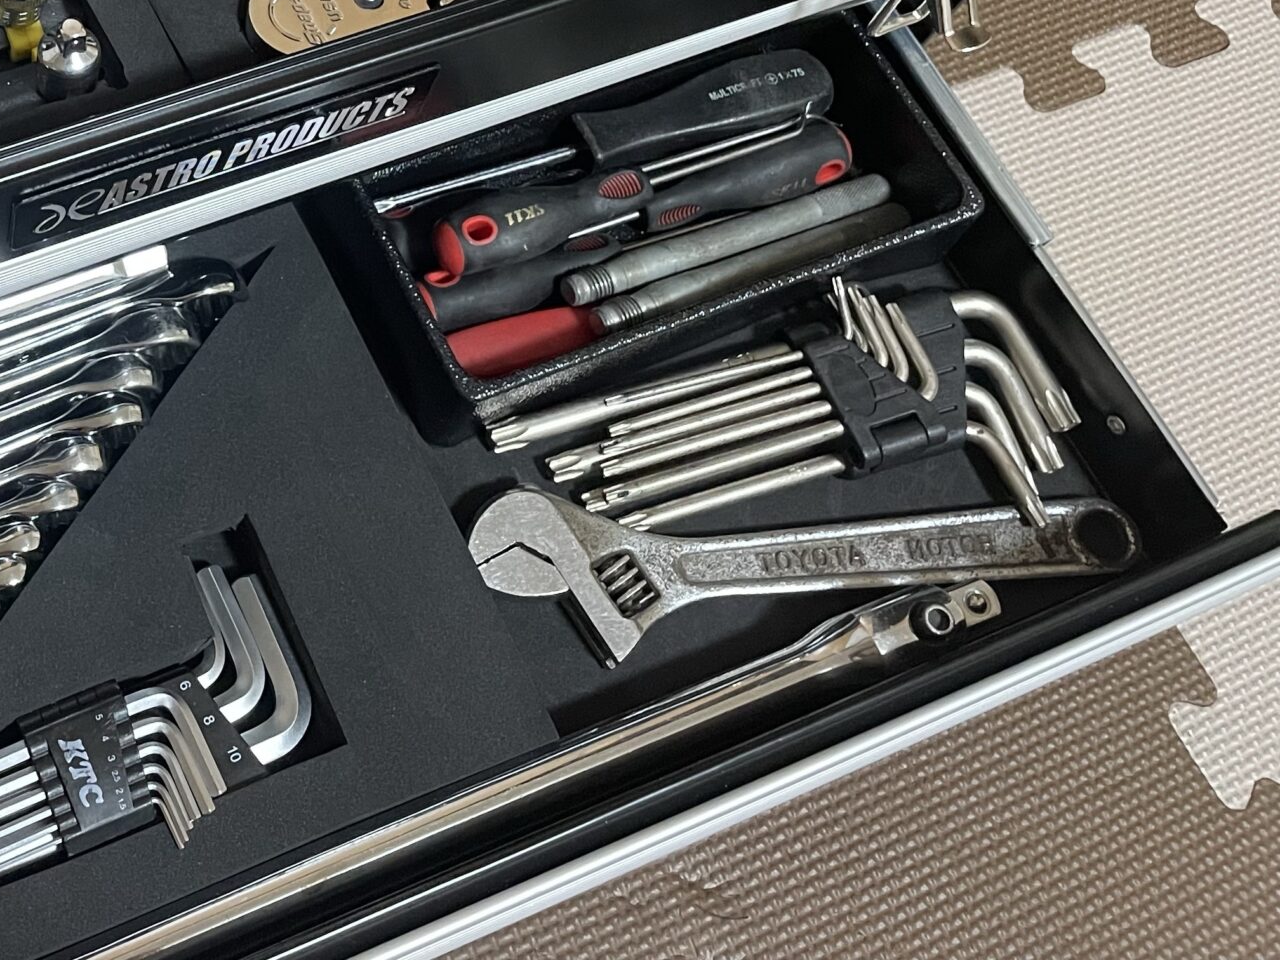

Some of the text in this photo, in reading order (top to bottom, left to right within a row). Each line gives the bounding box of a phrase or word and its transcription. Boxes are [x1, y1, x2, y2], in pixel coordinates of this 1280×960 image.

[97, 87, 416, 214] ASTRO PRODUCTS
[758, 545, 866, 573] TOYOTA
[179, 680, 191, 691] 6
[95, 713, 104, 721] 5
[203, 714, 216, 726] 8
[102, 735, 110, 743] 4
[107, 754, 116, 763] 3
[226, 745, 242, 764] 10
[57, 738, 104, 808] KTC
